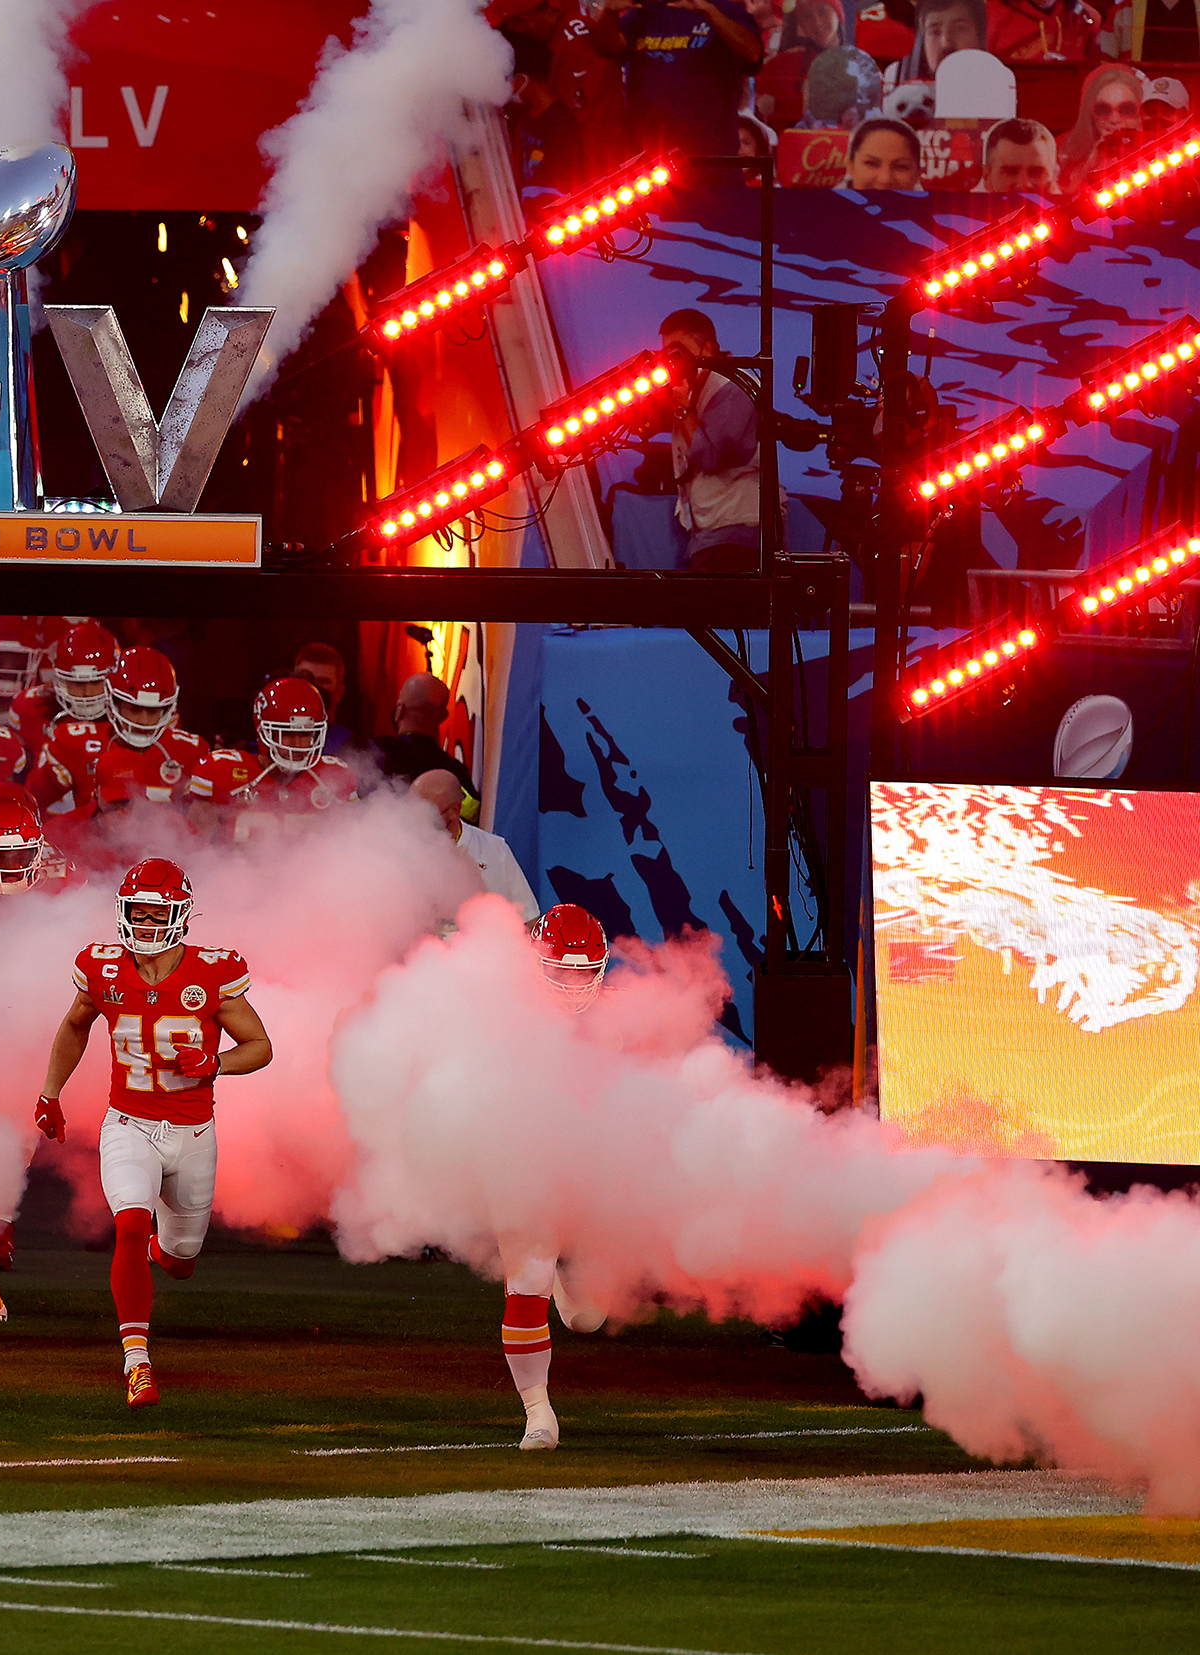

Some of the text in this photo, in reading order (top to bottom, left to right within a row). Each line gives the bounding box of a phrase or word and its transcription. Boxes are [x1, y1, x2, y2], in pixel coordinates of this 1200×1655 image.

[563, 19, 590, 41] 12
[70, 86, 169, 147] LV
[26, 527, 147, 551] BOWL
[232, 767, 249, 779] C
[101, 963, 119, 979] C
[103, 985, 125, 1004] LV
[112, 1013, 203, 1092] 49
